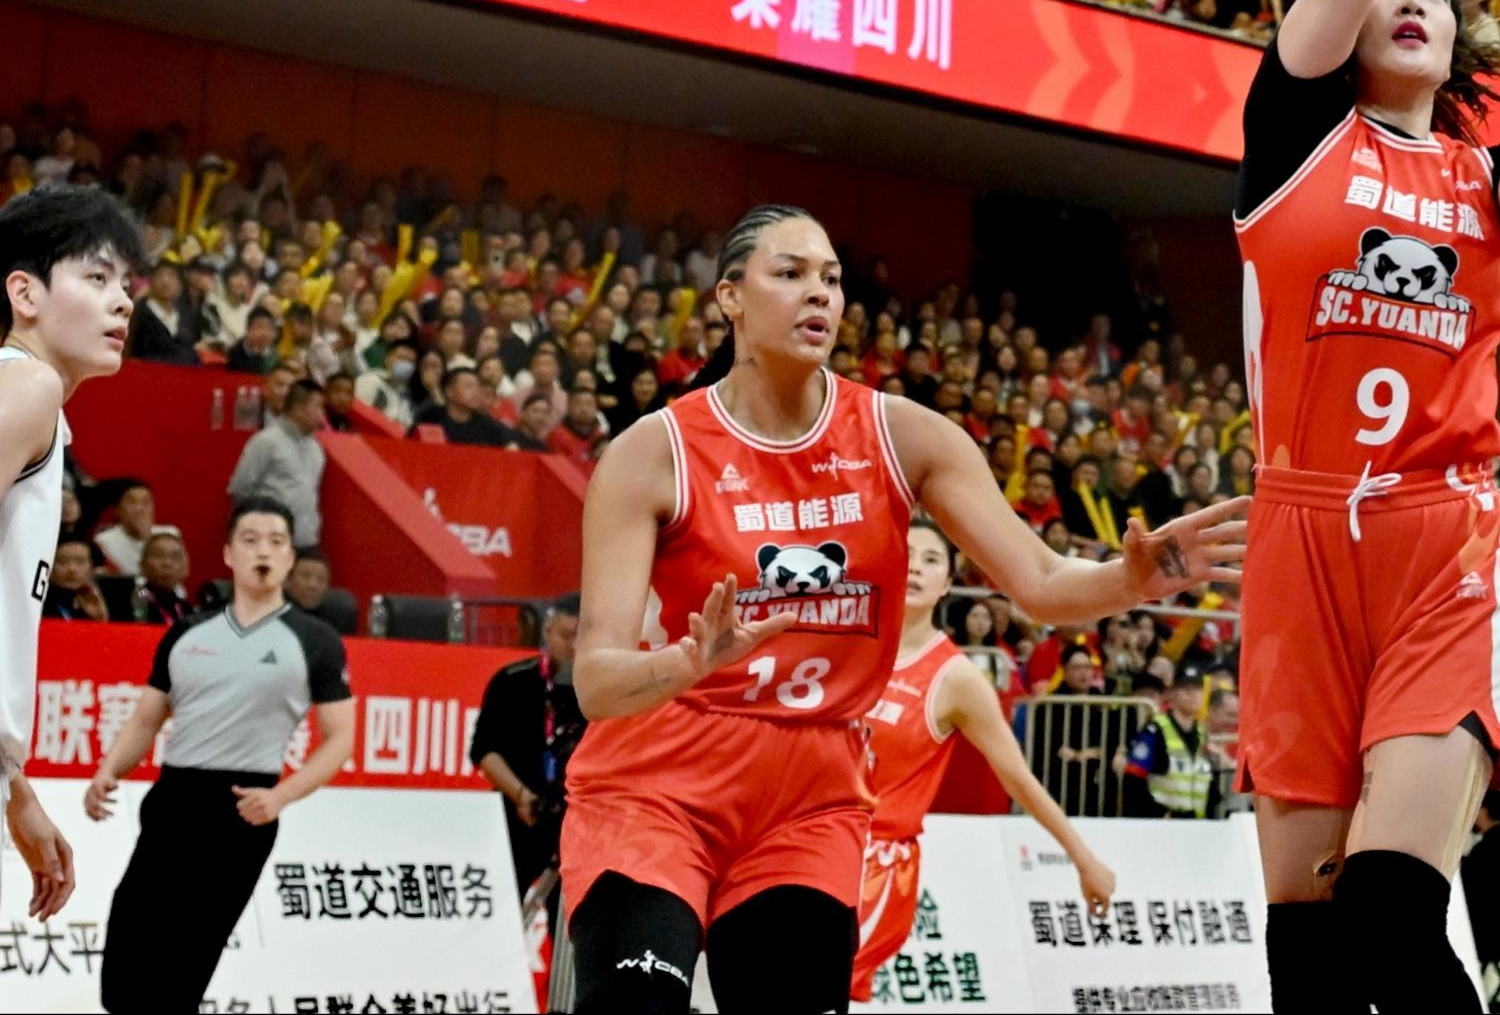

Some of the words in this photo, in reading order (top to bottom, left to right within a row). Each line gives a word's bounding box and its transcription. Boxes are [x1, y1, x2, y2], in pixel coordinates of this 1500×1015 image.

[1354, 367, 1411, 447] 9
[733, 491, 864, 533] 蜀道能源
[742, 655, 832, 710] 18
[364, 696, 484, 777] 四川
[274, 862, 494, 919] 蜀道交通服务
